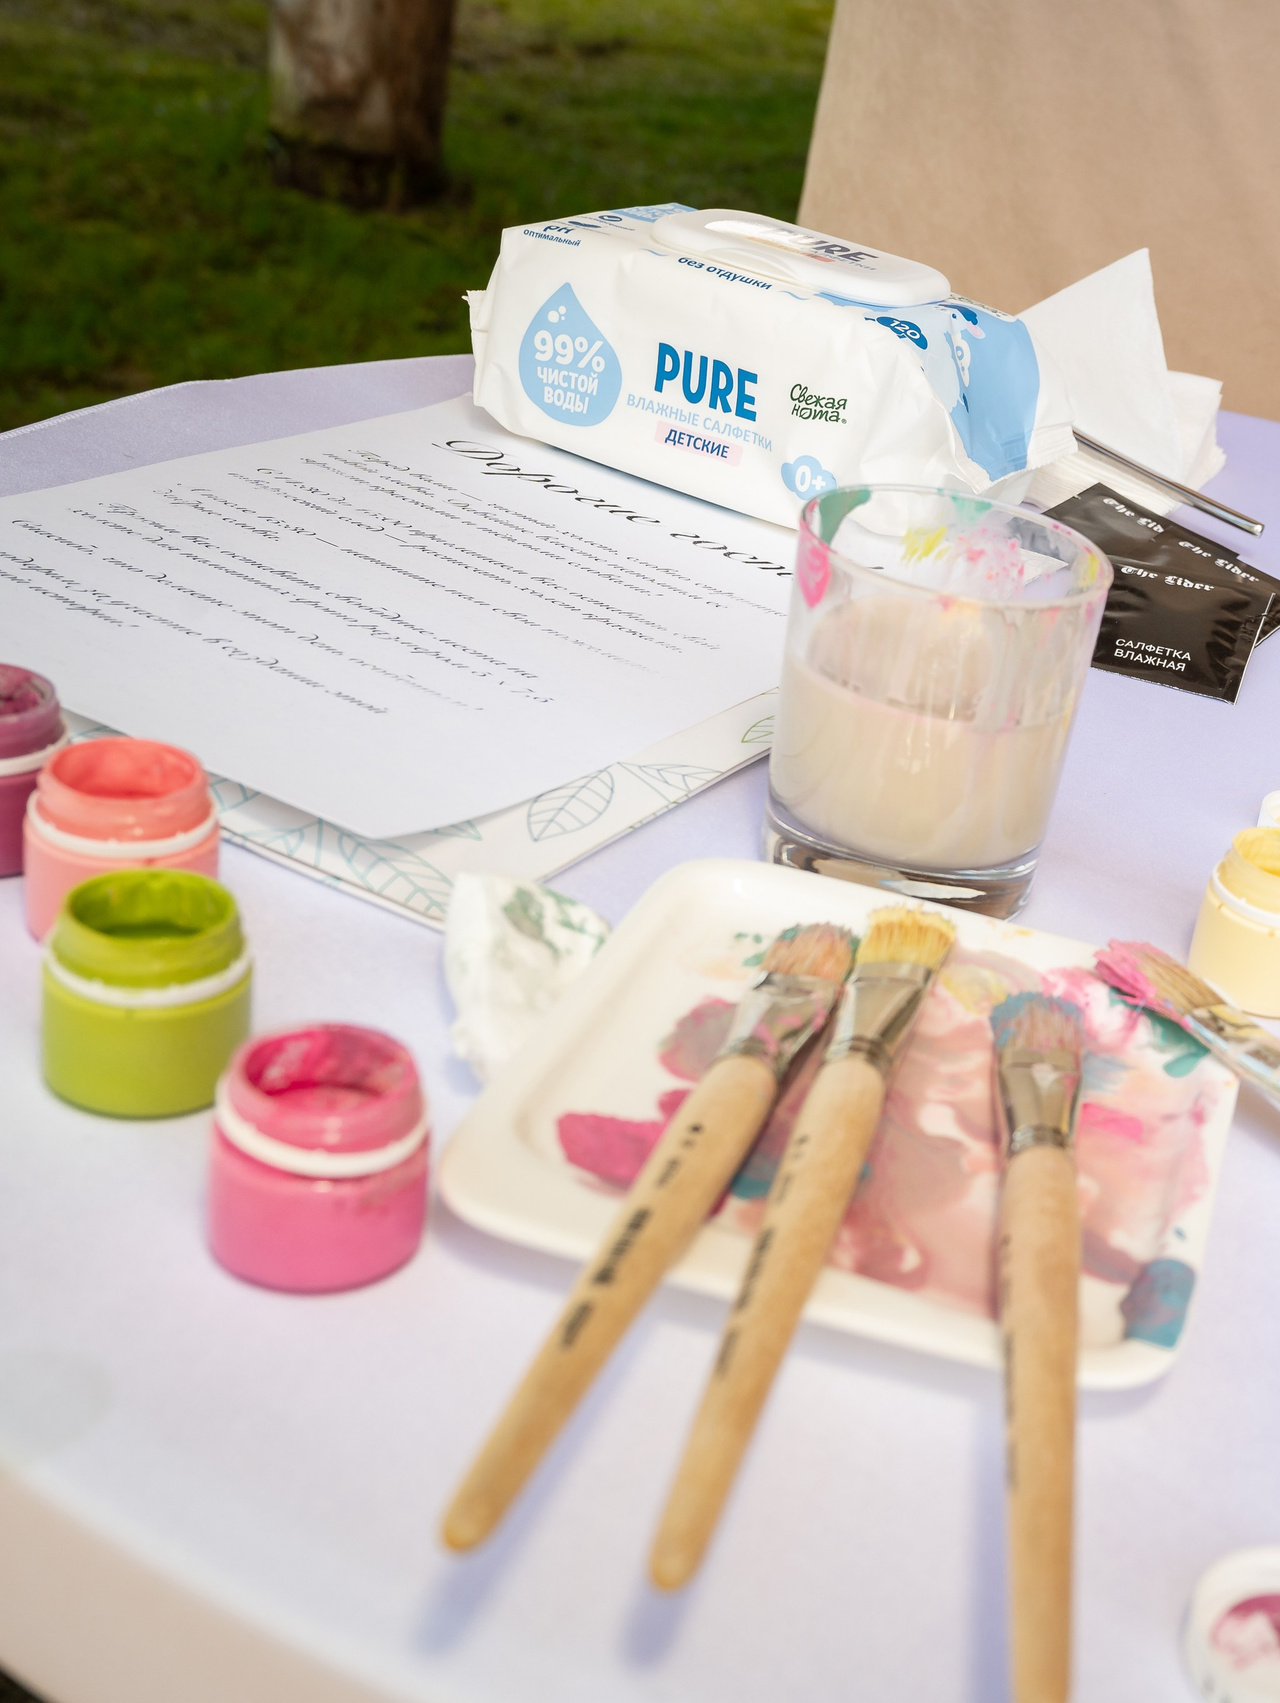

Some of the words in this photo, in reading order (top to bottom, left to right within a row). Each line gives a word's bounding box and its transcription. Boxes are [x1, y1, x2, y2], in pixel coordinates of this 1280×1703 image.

[523, 229, 582, 247] оптимальный
[678, 257, 705, 270] без
[706, 266, 773, 290] отдушки
[889, 319, 920, 340] 120
[534, 330, 605, 373] 99%
[537, 366, 598, 396] ЧИСТОЙ
[654, 342, 758, 422] PURE
[543, 386, 589, 414] ВОДЫ
[789, 383, 848, 410] Свежая
[626, 393, 700, 427] ВЛАЖНЫЕ
[702, 416, 773, 452] САЛФЕТКИ
[664, 428, 730, 459] ДЕТСКИЕ
[794, 464, 827, 492] 0+
[431, 443, 661, 524] Дорогие
[669, 532, 794, 577] гост
[1178, 540, 1211, 558] The
[1120, 565, 1159, 580] The
[1113, 648, 1187, 672] ВЛАЖНАЯ
[1115, 638, 1192, 661] САЛФЕТКА
